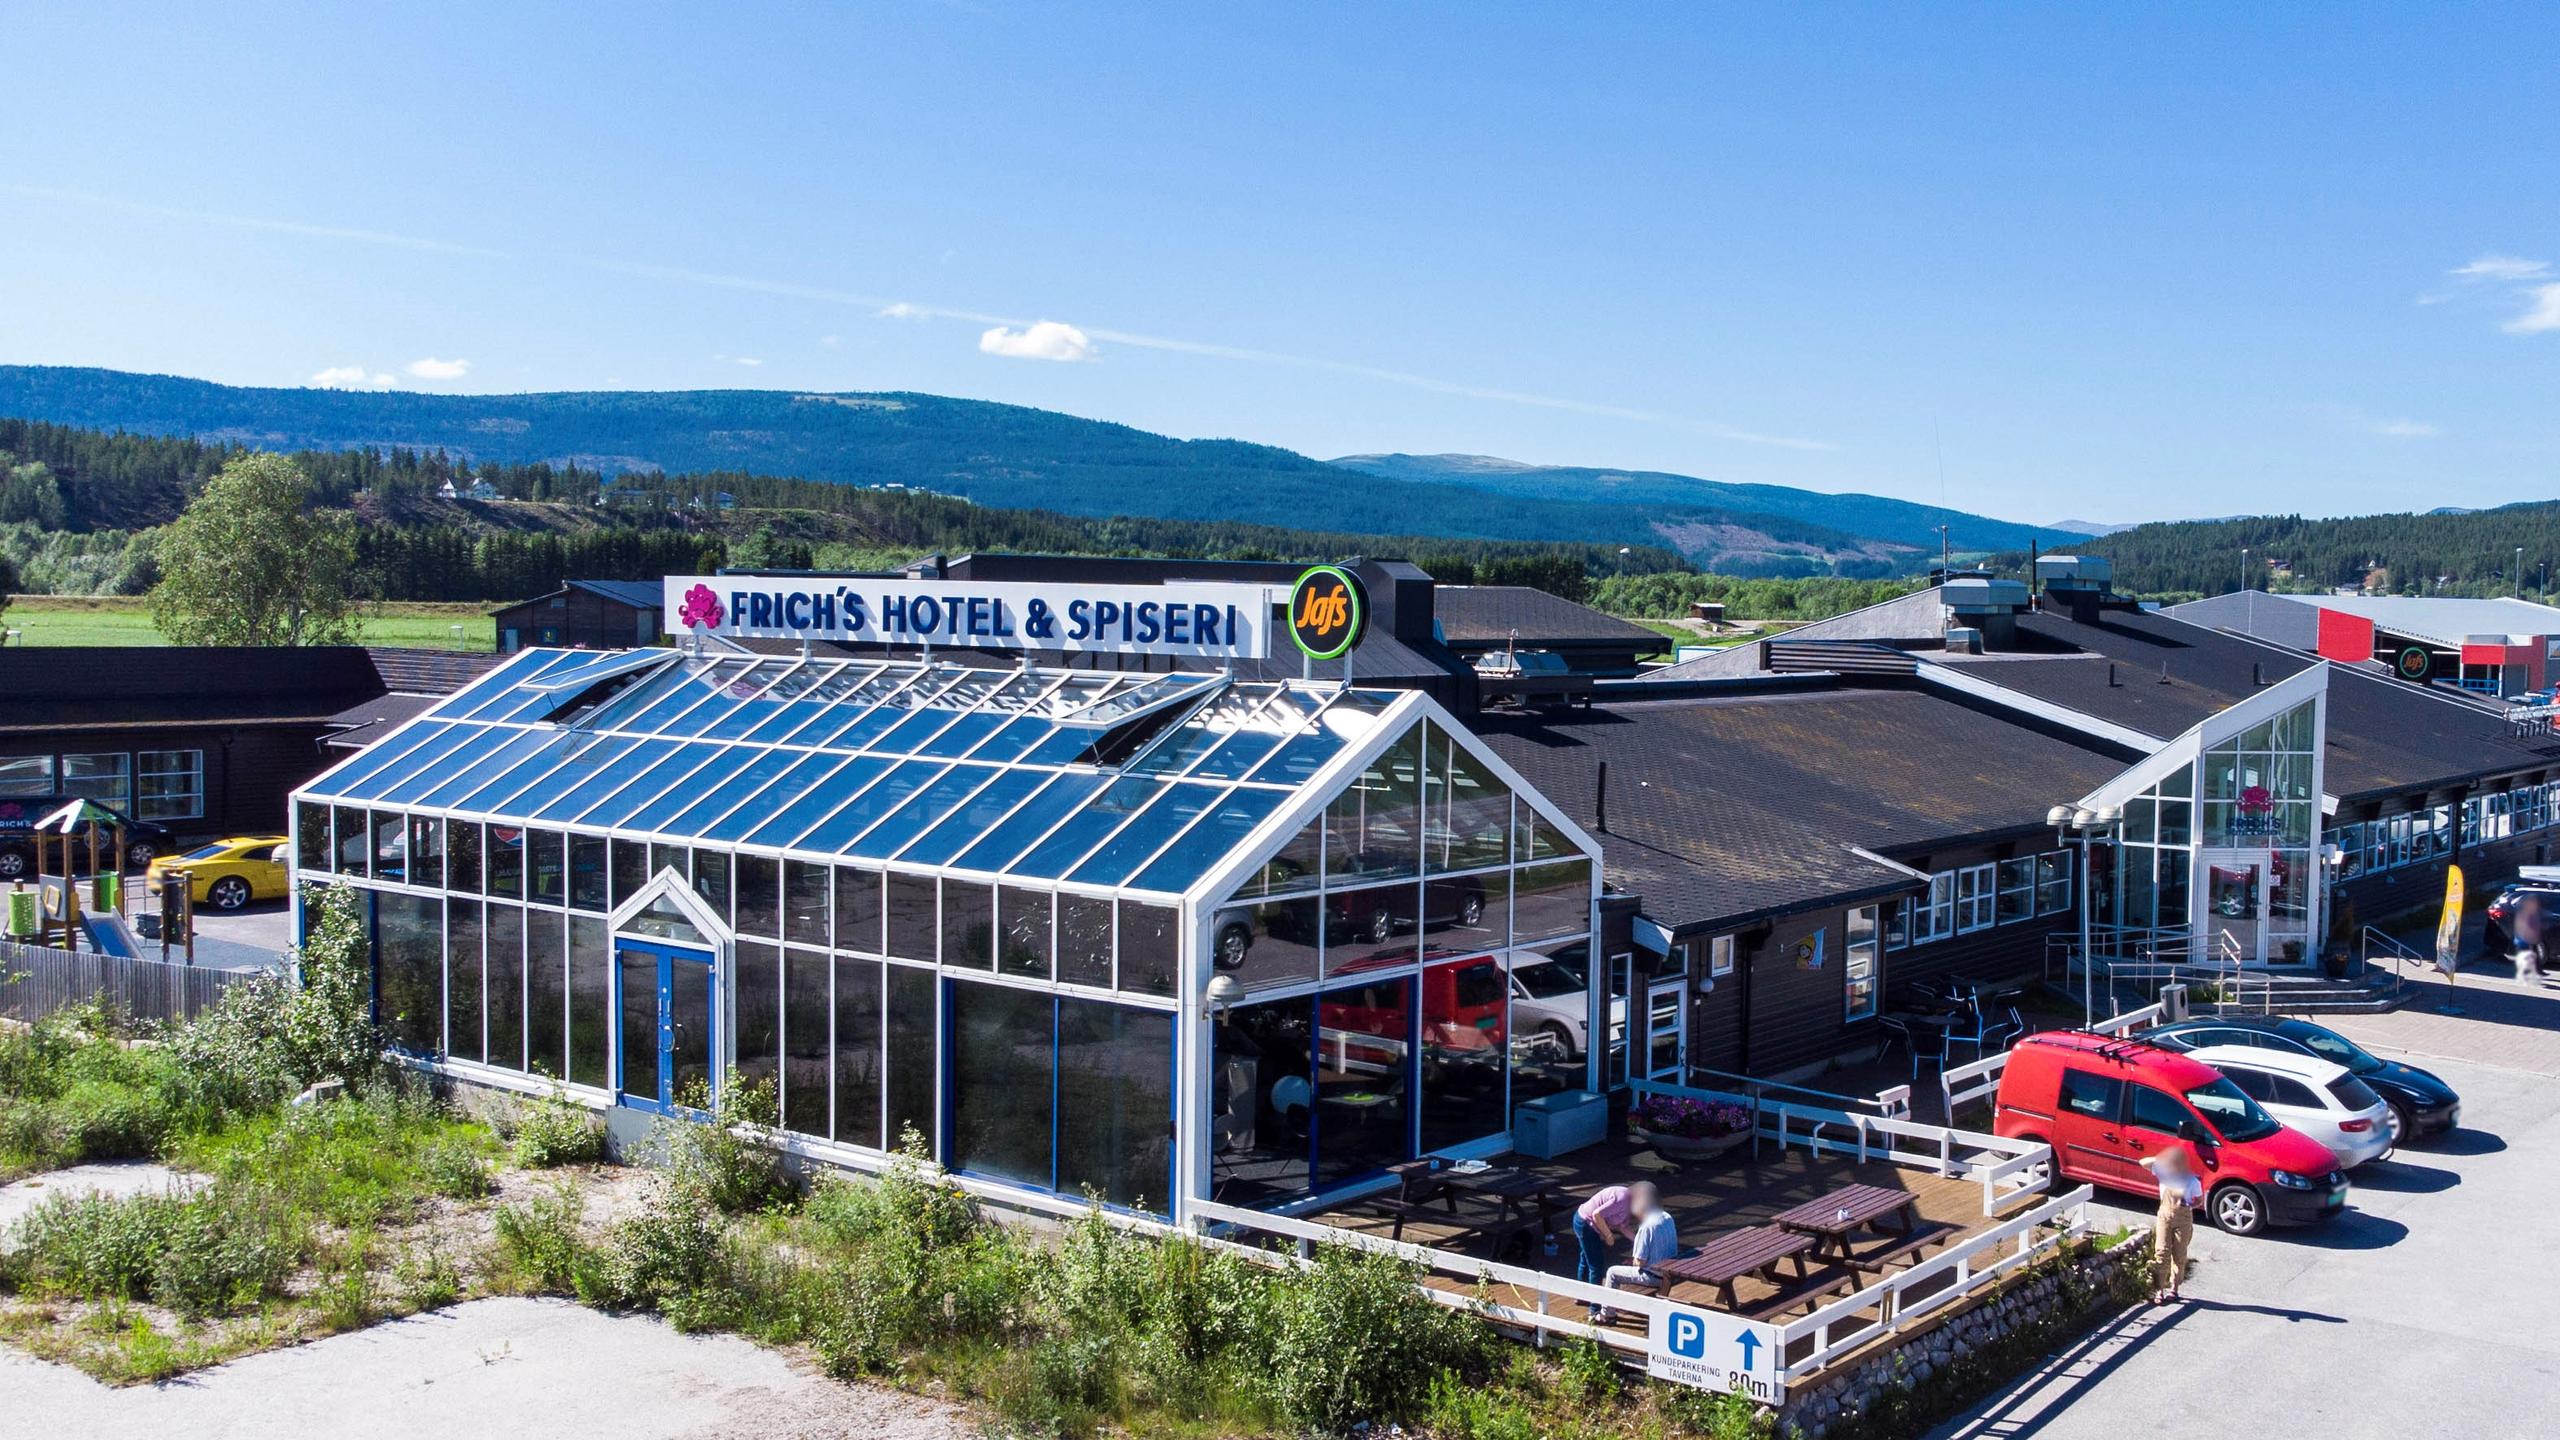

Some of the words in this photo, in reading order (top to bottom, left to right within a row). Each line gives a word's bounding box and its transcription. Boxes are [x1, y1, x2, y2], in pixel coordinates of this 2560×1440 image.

[731, 586, 865, 632] FRICH'S
[882, 595, 1014, 638] HOTEL
[1025, 598, 1054, 639] &
[1067, 599, 1237, 646] SPISERI
[1296, 584, 1348, 636] Jafs
[1676, 1318, 1699, 1351] P
[1651, 1353, 1721, 1378] KUNDEPARKERING
[1667, 1367, 1703, 1385] TAVERNA
